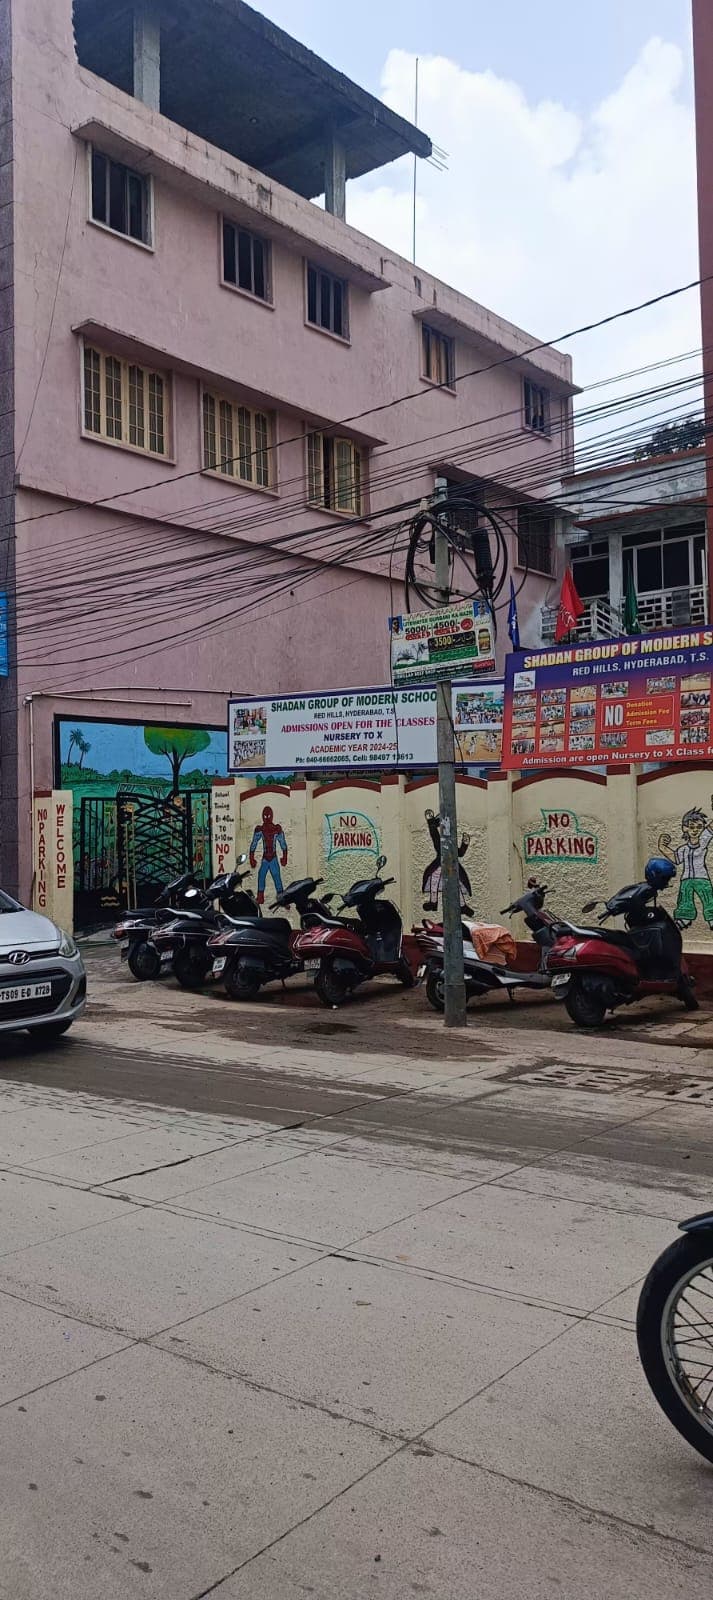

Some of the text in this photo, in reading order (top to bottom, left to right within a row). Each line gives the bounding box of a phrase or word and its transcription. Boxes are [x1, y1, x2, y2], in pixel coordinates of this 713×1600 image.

[524, 631, 713, 668] SHADAN GROUP OF MODERN S
[572, 652, 710, 676] RED HILLS, HYDERABAD, T.S.
[271, 690, 438, 712] SHADAN GROUP OF MODERN SCHOO
[626, 700, 653, 708] Donation
[604, 704, 624, 726] NO
[642, 718, 658, 726] Fees
[281, 716, 435, 733] ADMISSIONS OPEN FOR THE CLASSES
[324, 731, 383, 742] NURSERY TO X
[310, 742, 398, 754] ACADEMIC YEAR 2024-25
[522, 756, 567, 765] Admission
[586, 754, 609, 763] open
[612, 751, 650, 760] Nursery
[653, 750, 663, 758] to
[666, 748, 673, 757] X
[676, 748, 704, 756] Class
[340, 816, 357, 827] NO
[548, 813, 570, 828] NO
[56, 804, 66, 889] WELCOME
[334, 832, 372, 848] PARKING
[527, 837, 595, 856] PARKING
[216, 844, 230, 854] NO
[37, 808, 48, 908] NO PARKING
